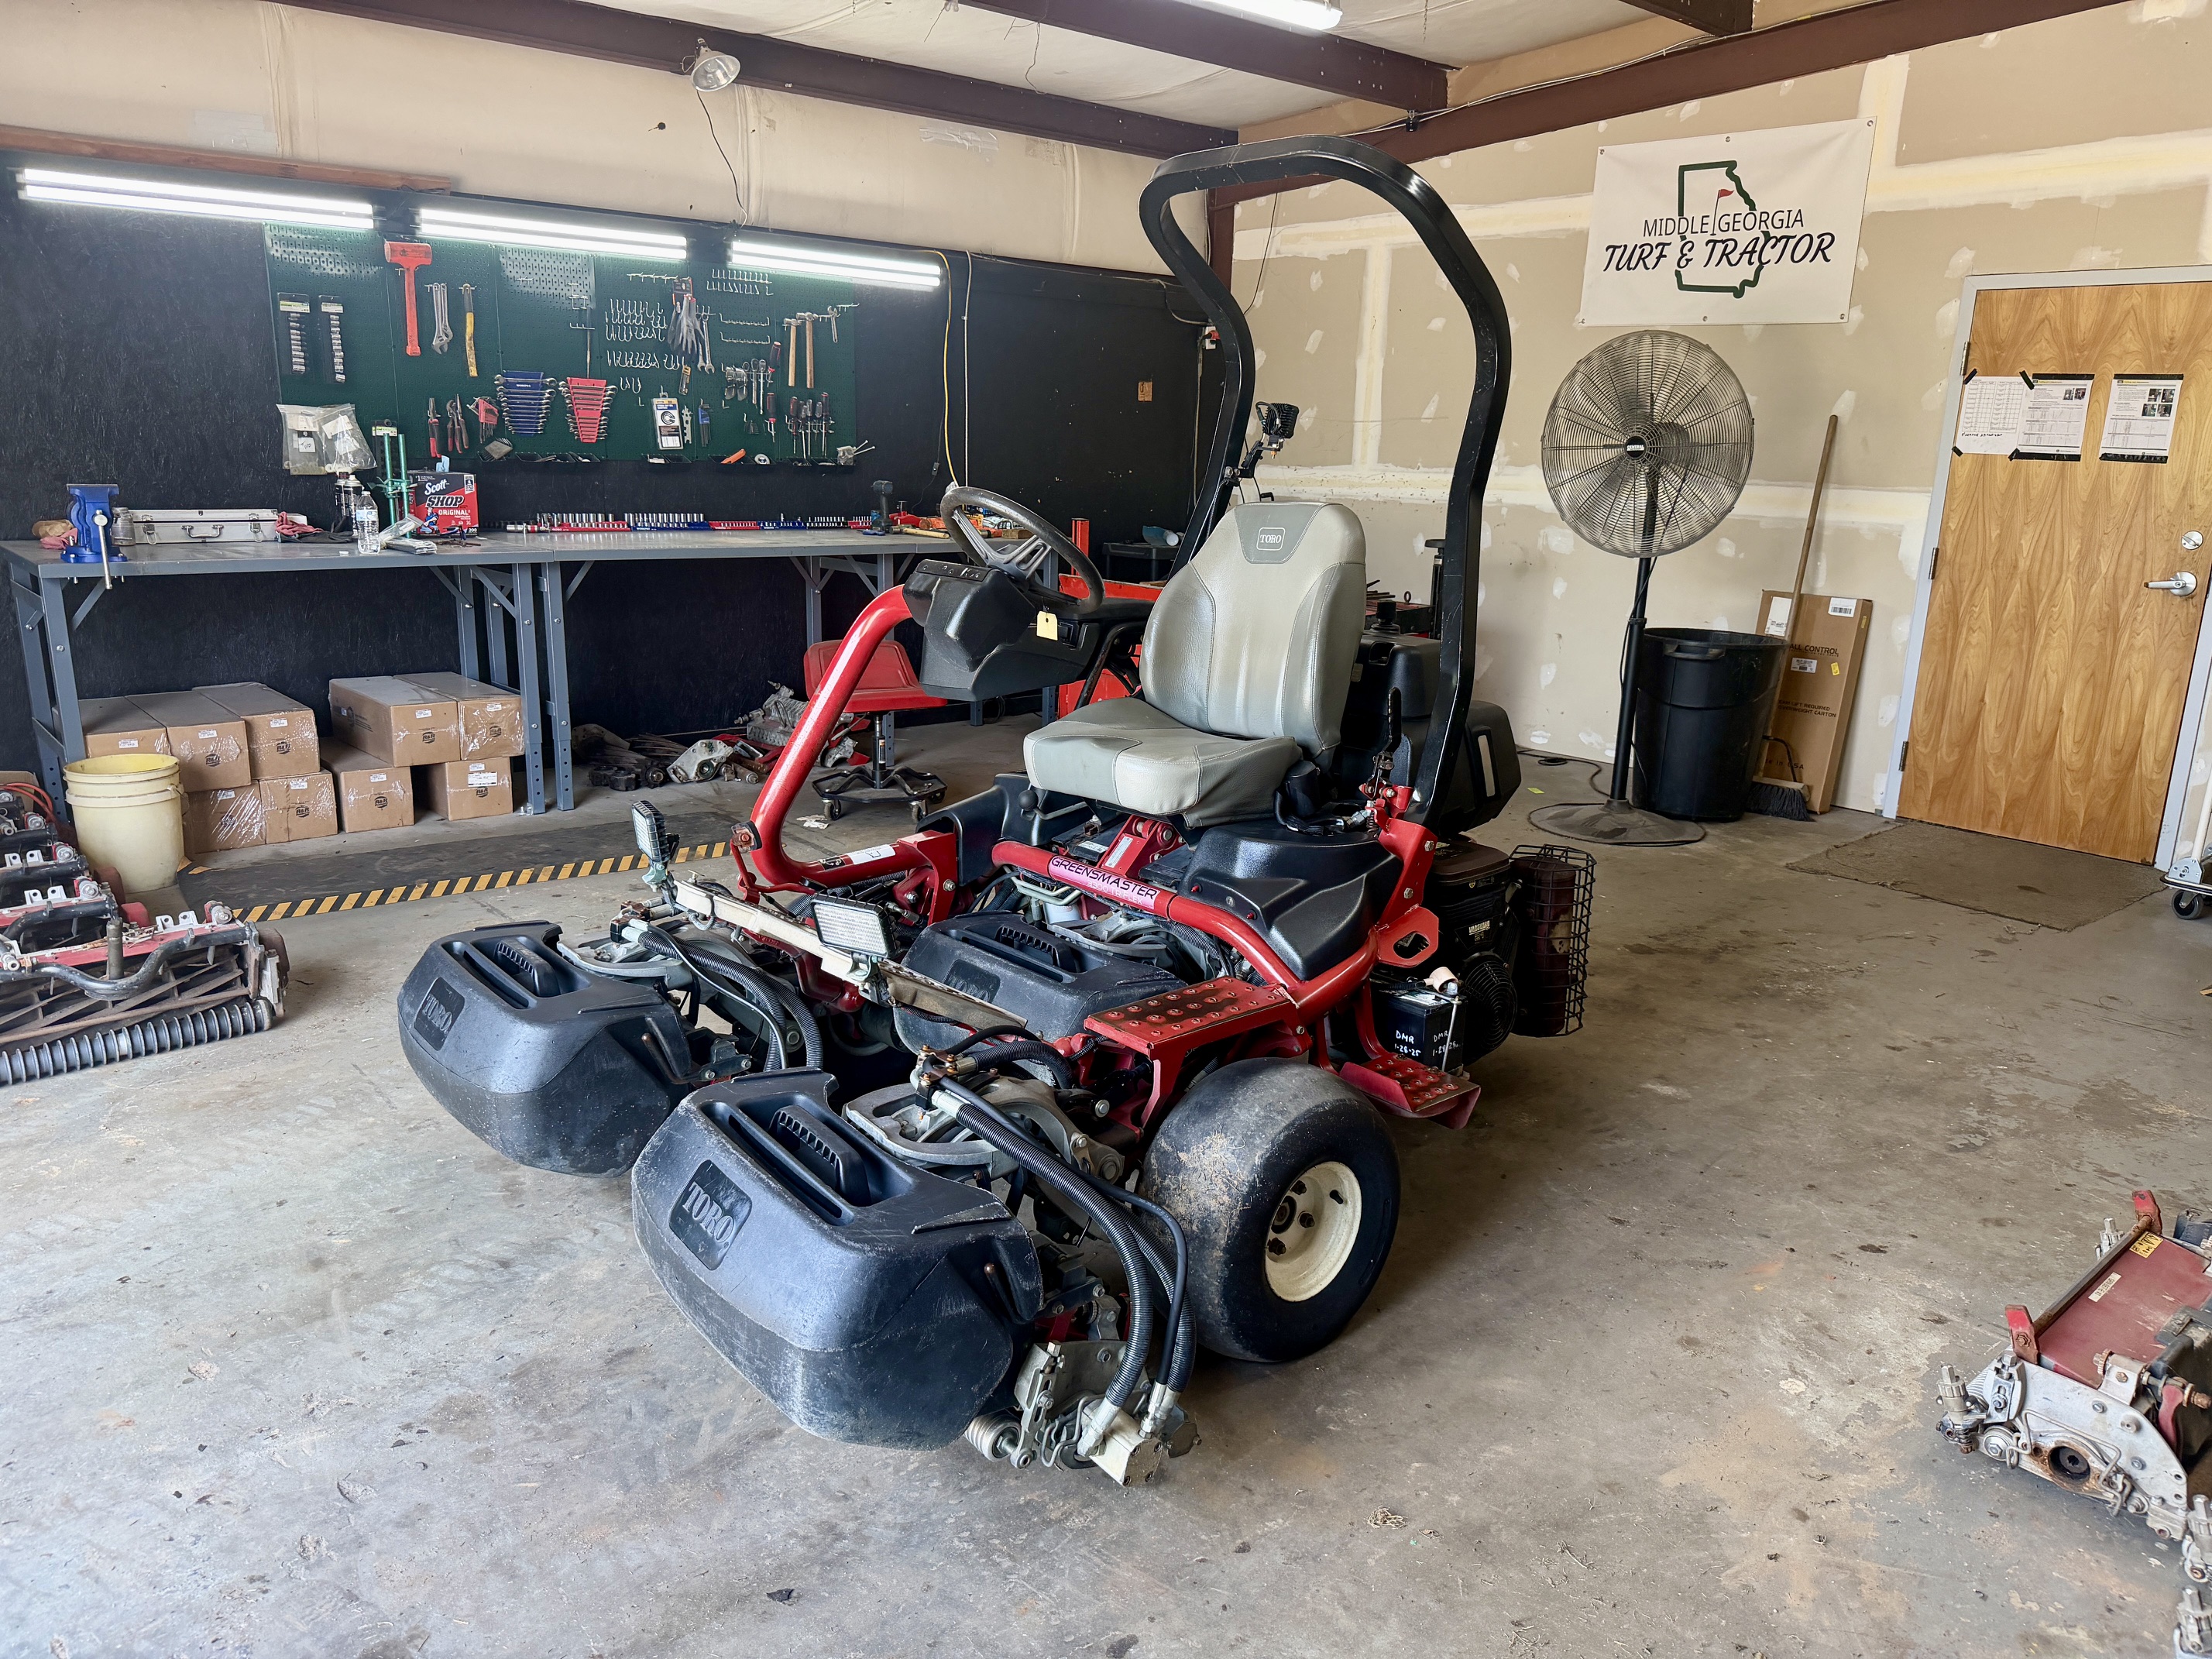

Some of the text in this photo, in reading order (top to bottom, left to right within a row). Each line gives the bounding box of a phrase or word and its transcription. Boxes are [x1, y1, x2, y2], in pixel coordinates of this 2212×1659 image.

[1643, 208, 1805, 237] MIDDLE GEORGIA
[1602, 233, 1836, 272] TURF & TRACTOR
[424, 478, 447, 495] Scott
[425, 495, 464, 508] SHOP
[1260, 534, 1282, 543] TORO
[1805, 644, 1839, 654] CONTROL
[1778, 705, 1813, 714] OVERWEIGHT
[1804, 702, 1830, 711] REQUIRED
[1051, 857, 1158, 899] GREENSMASTER
[1087, 881, 1144, 905] 3300 TRIFLEX
[422, 994, 452, 1031] TORO
[1396, 1029, 1414, 1044] DMR
[1394, 1043, 1421, 1056] 1-28-25
[682, 1180, 734, 1243] TORO
